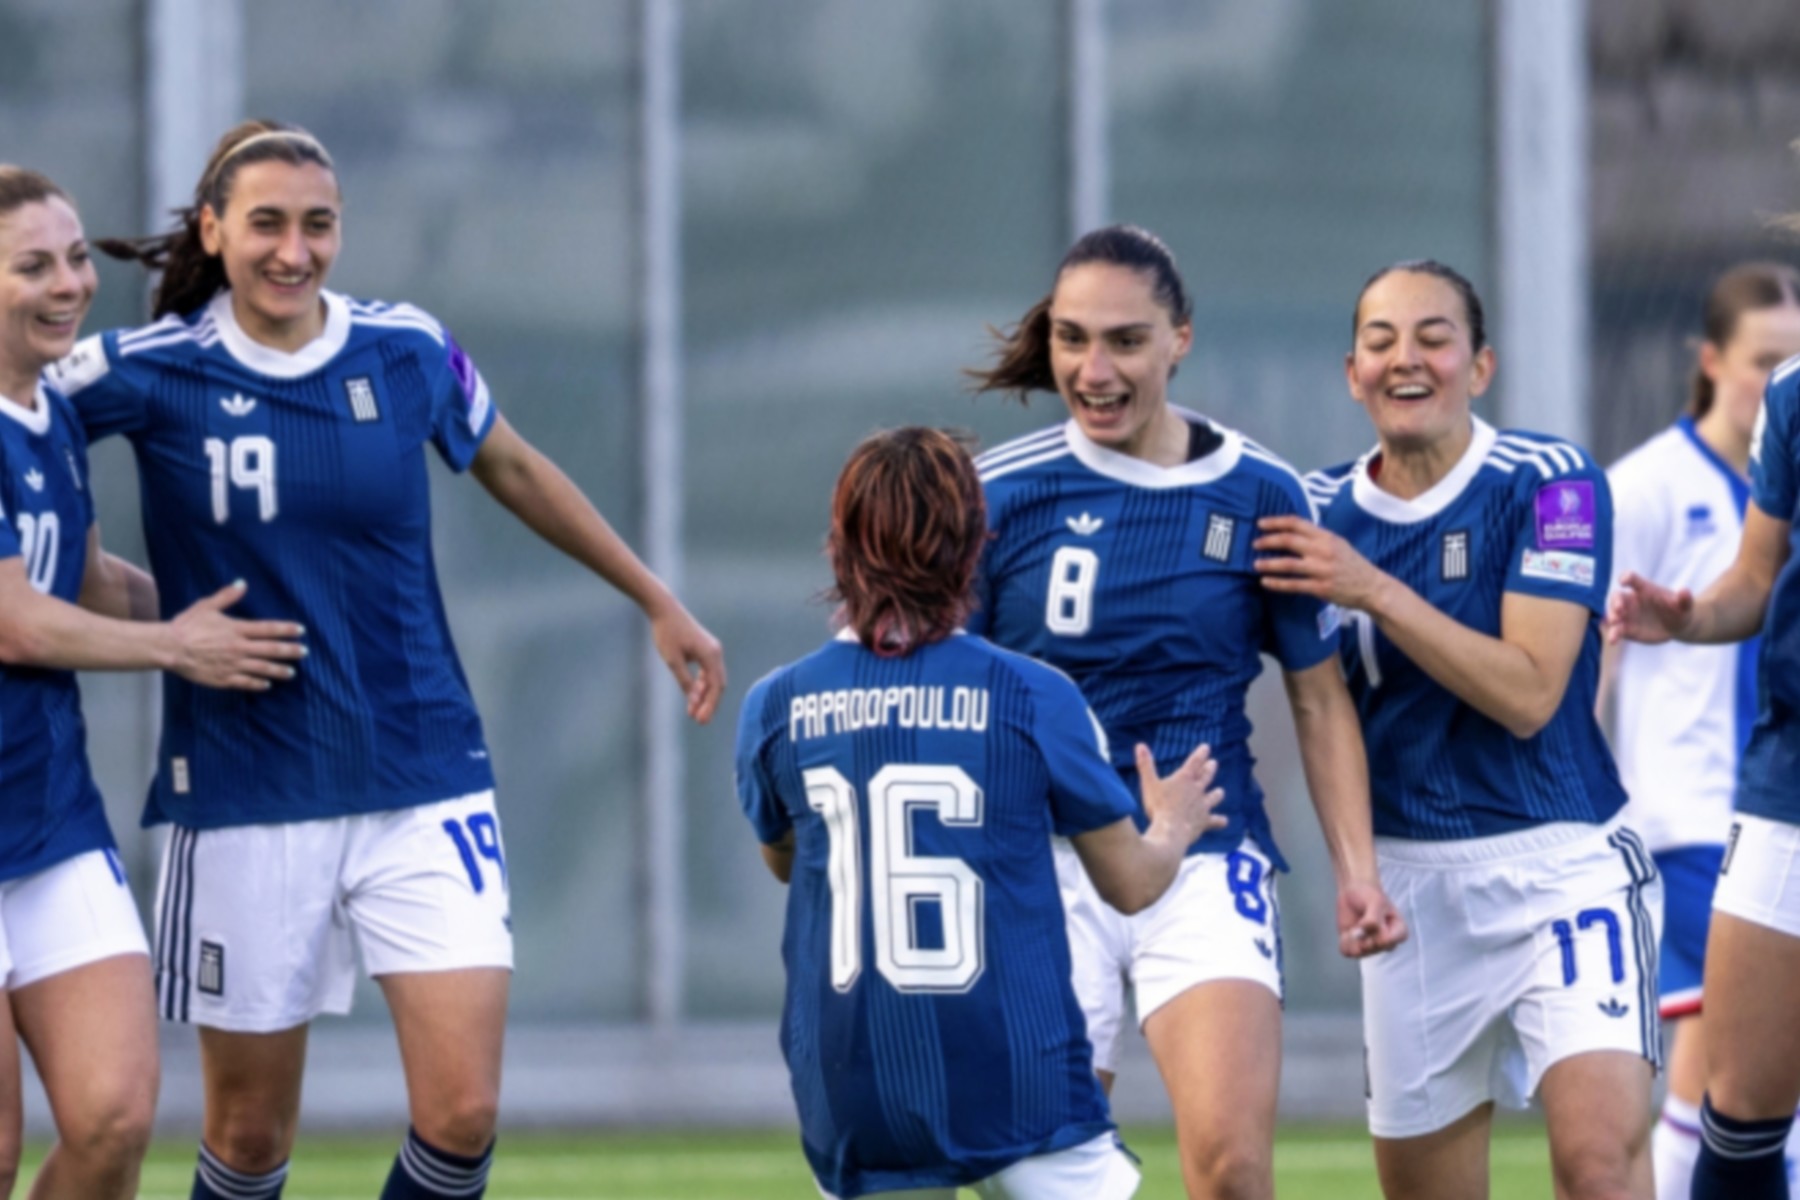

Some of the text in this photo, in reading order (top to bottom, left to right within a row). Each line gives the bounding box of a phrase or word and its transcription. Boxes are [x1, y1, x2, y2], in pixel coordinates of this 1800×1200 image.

[204, 436, 278, 523] 19
[17, 512, 60, 594] 10
[1046, 546, 1098, 635] 8
[789, 686, 989, 742] PAPADOPOULOU
[442, 811, 508, 893] 19
[801, 763, 985, 994] 16
[1226, 850, 1267, 925] 8
[1551, 908, 1625, 987] 17
